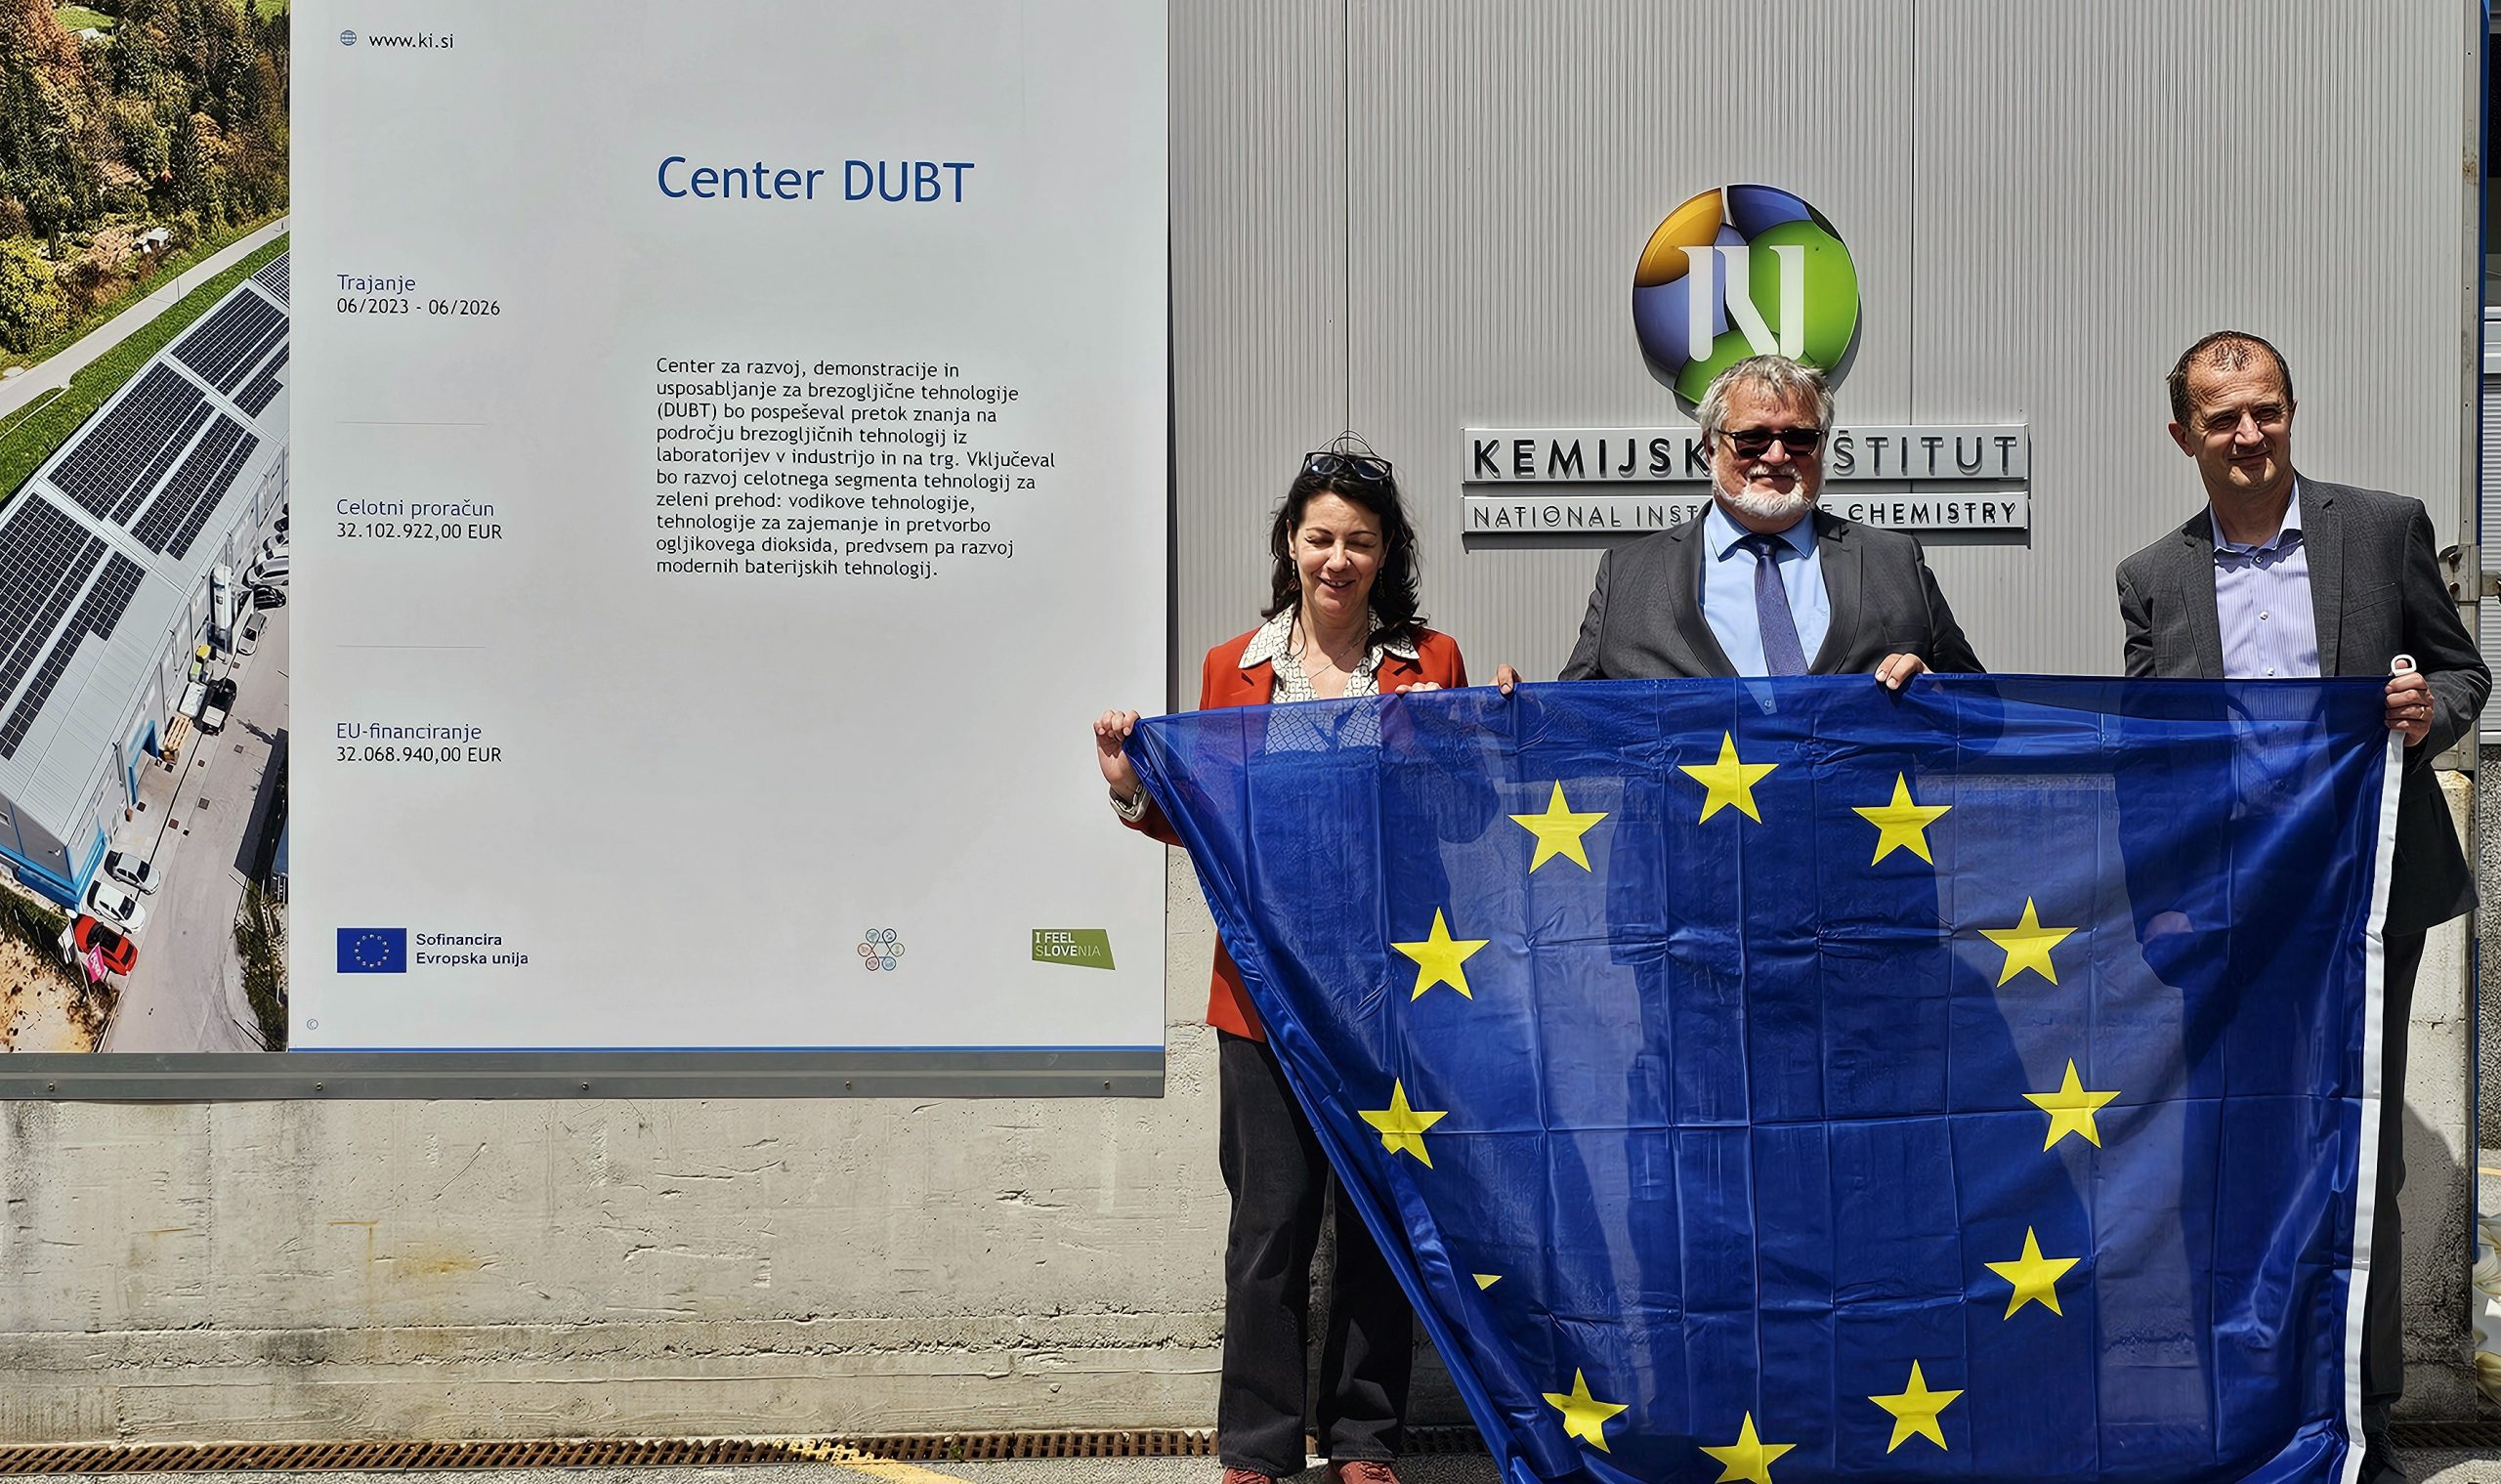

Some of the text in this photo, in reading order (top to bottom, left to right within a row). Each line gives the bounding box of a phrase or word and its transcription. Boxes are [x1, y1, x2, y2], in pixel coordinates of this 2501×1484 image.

[368, 31, 454, 49] www.ki.si
[657, 155, 975, 203] Center DUBT
[336, 274, 416, 296] Trajanje
[336, 297, 409, 315] 06/2023
[428, 299, 501, 317] 06/2026
[656, 357, 959, 381] Center za razvoj, demonstracije in
[657, 380, 1019, 405] usposabljanje za brezogljične tehnologije
[657, 402, 997, 426] (DUBT) bo pospeševal pretok znanja na
[657, 423, 968, 448] področju brezogljičnih tehnologij iz
[657, 445, 1056, 471] laboratorijev v industrijo in na trg. Vključeval
[1472, 430, 2016, 479] KEMIJSK ŠTITUT
[657, 468, 1036, 493] bo razvoj celotnega segmenta tehnologij za
[336, 498, 494, 520] Celotni proračun
[656, 490, 975, 515] zeleni prehod: vodikove tehnologije,
[657, 513, 991, 535] tehnologije za zajemanje in pretvorbo
[1472, 505, 1622, 528] NATIONAL
[1635, 504, 1698, 527] INST
[1847, 502, 2015, 526] CHEMISTRY
[336, 522, 503, 542] 32.102.922,00 EUR
[656, 534, 1013, 559] ogljikovega dioksida, predvsem pa razvoj
[657, 557, 938, 580] modernih baterijskih tehnologij.
[336, 722, 483, 743] EU-financiranje
[336, 745, 502, 766] 32.068.940,00 EUR
[415, 932, 502, 946] Sofinancira
[1035, 932, 1076, 944] I FEEL
[416, 952, 529, 968] Evropska unija
[1035, 945, 1102, 957] SLOVENIA
